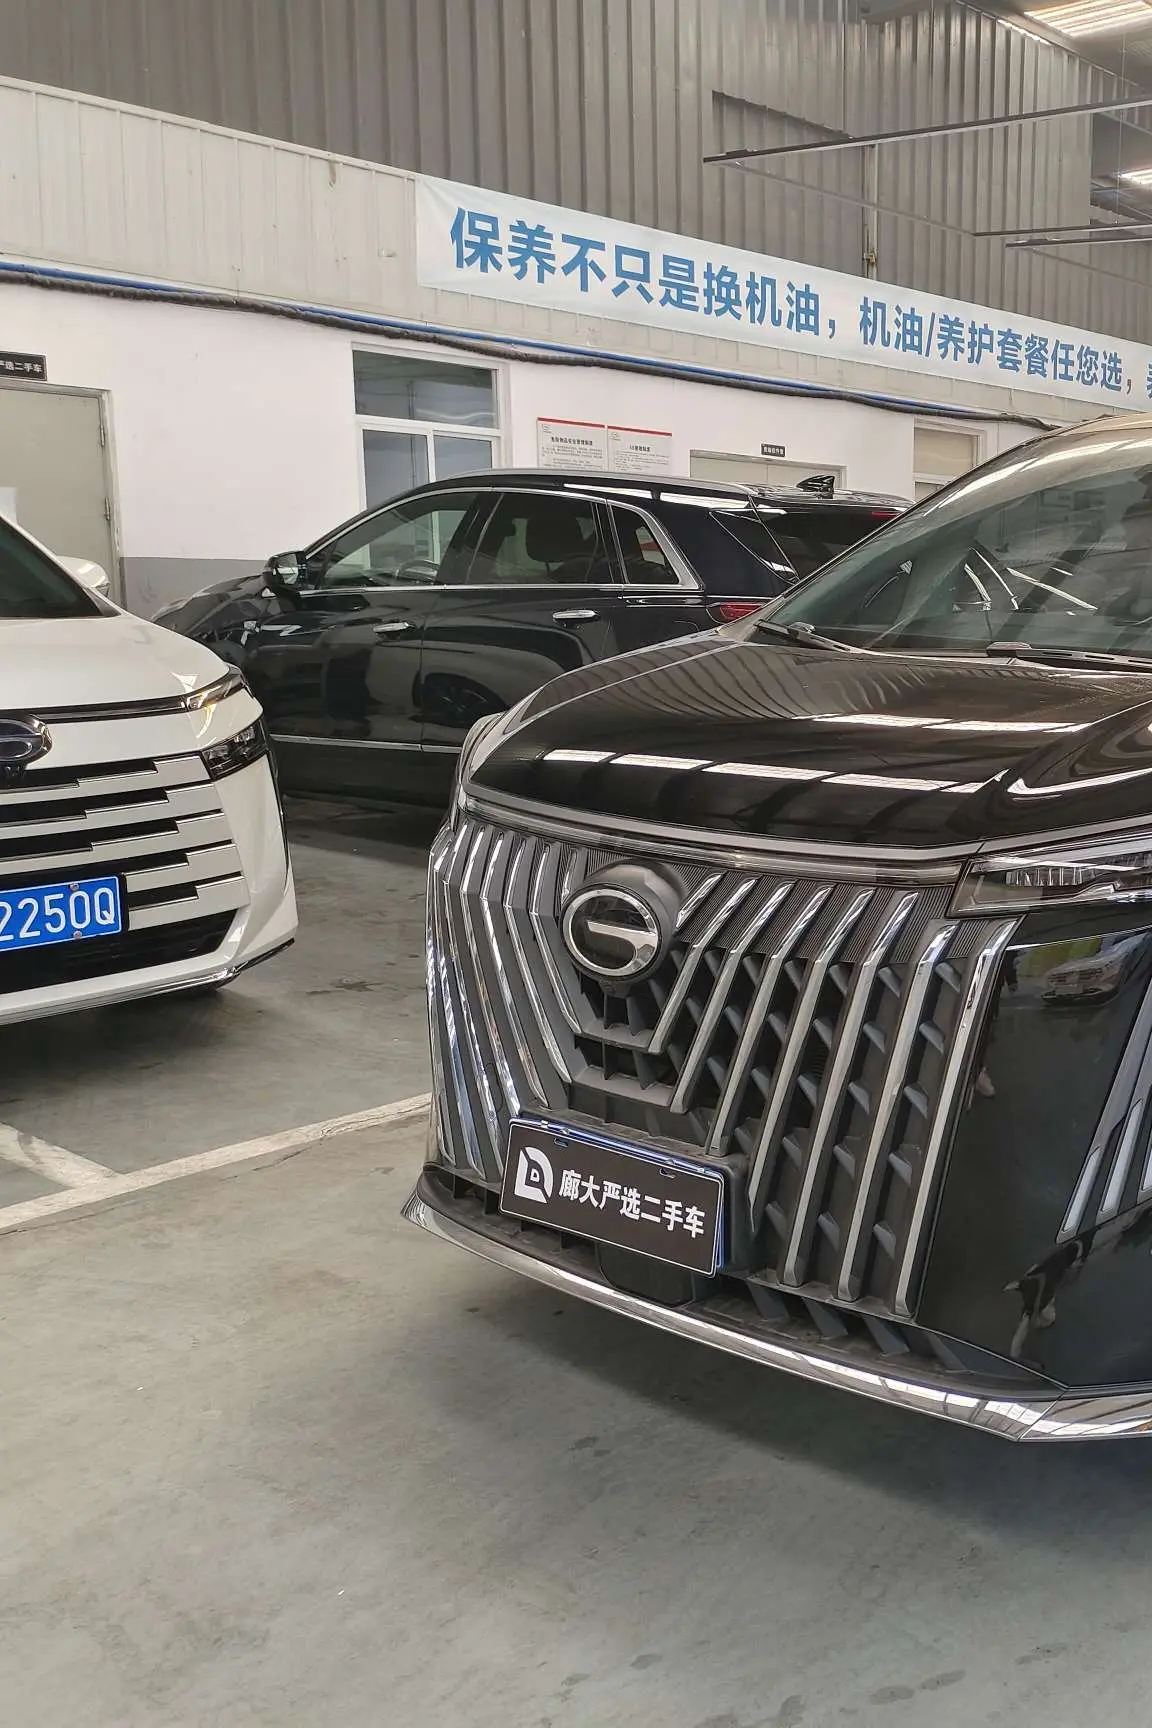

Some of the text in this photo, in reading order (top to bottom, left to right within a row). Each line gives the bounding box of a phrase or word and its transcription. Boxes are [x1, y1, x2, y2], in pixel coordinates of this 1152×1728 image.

[0, 887, 115, 942] 2250Q
[559, 1168, 706, 1239] 廊大严选二手车
